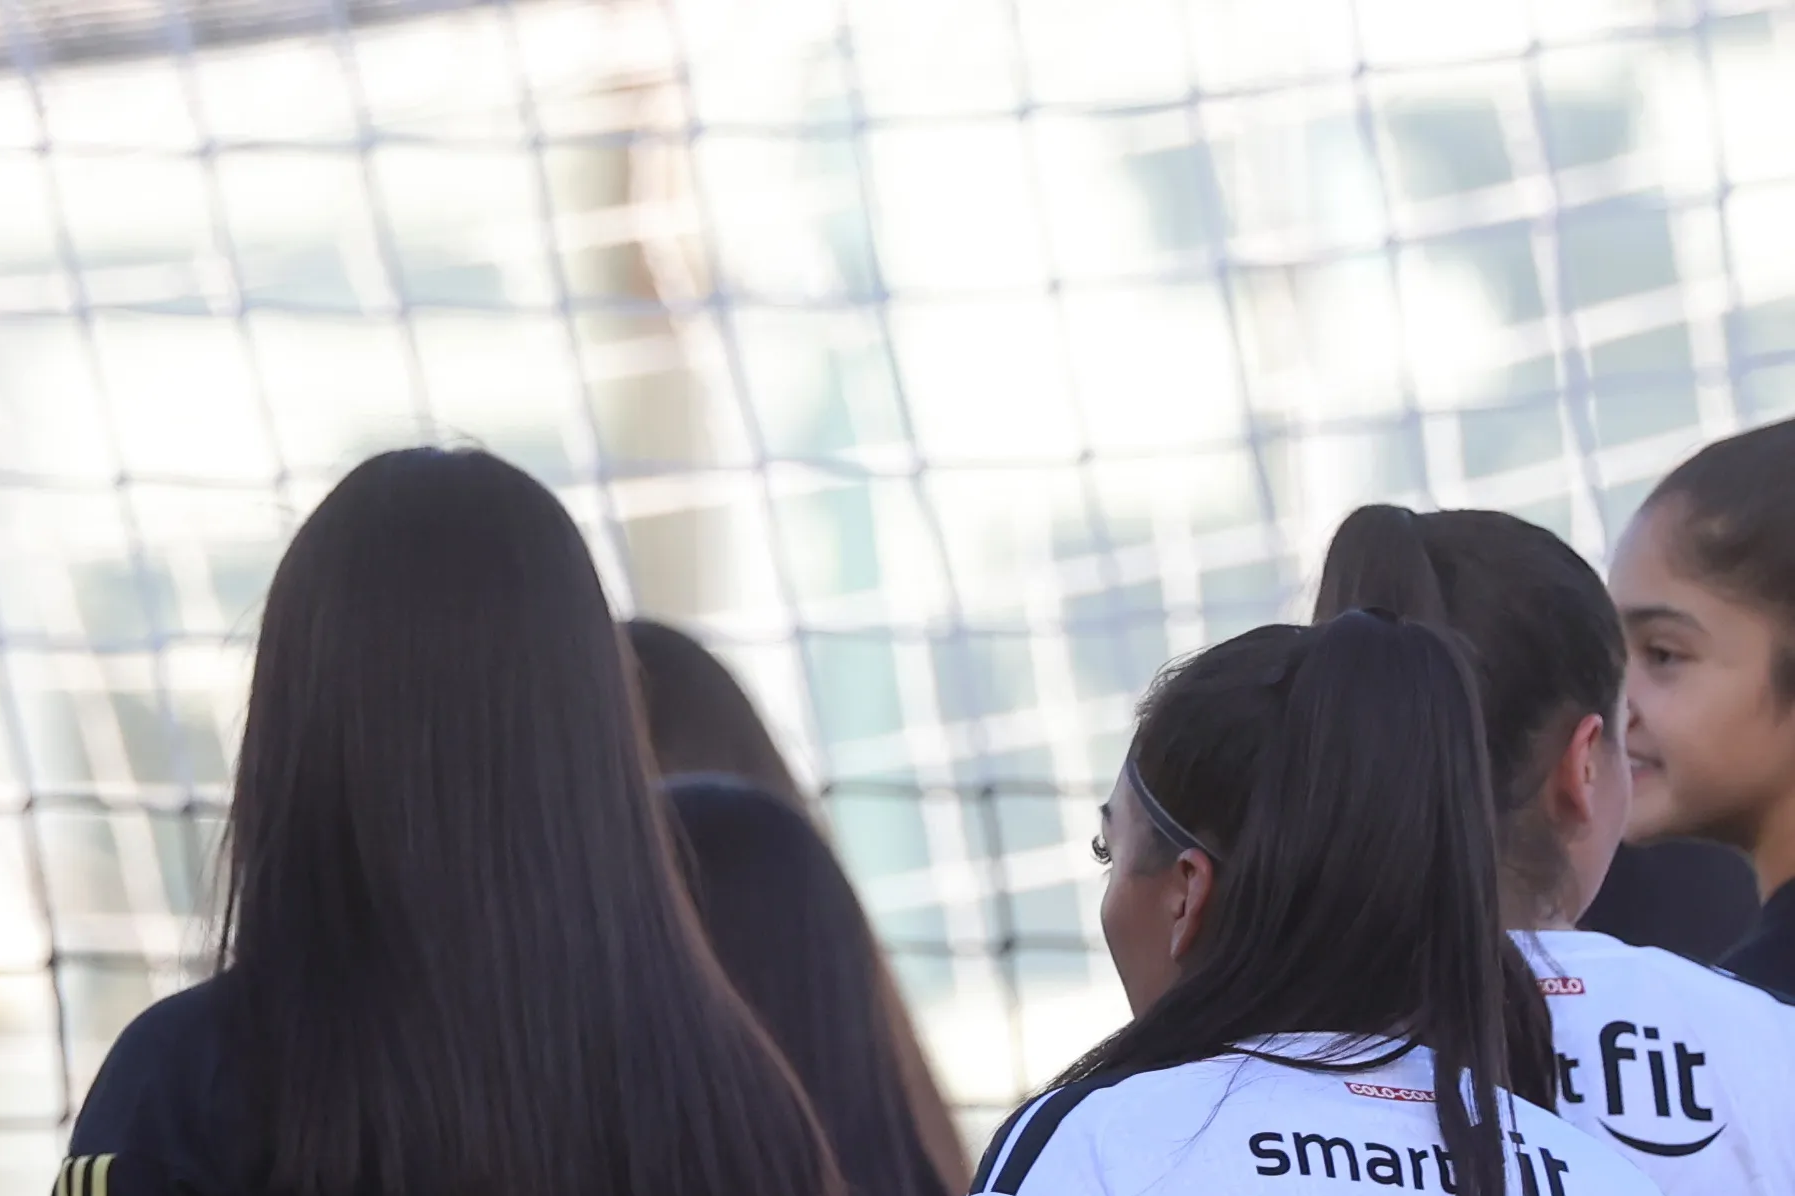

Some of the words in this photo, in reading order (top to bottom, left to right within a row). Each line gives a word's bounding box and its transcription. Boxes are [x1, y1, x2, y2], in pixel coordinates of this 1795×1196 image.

[1541, 978, 1582, 993] OLO
[1598, 1020, 1714, 1122] fit
[1249, 1130, 1459, 1195] smart
